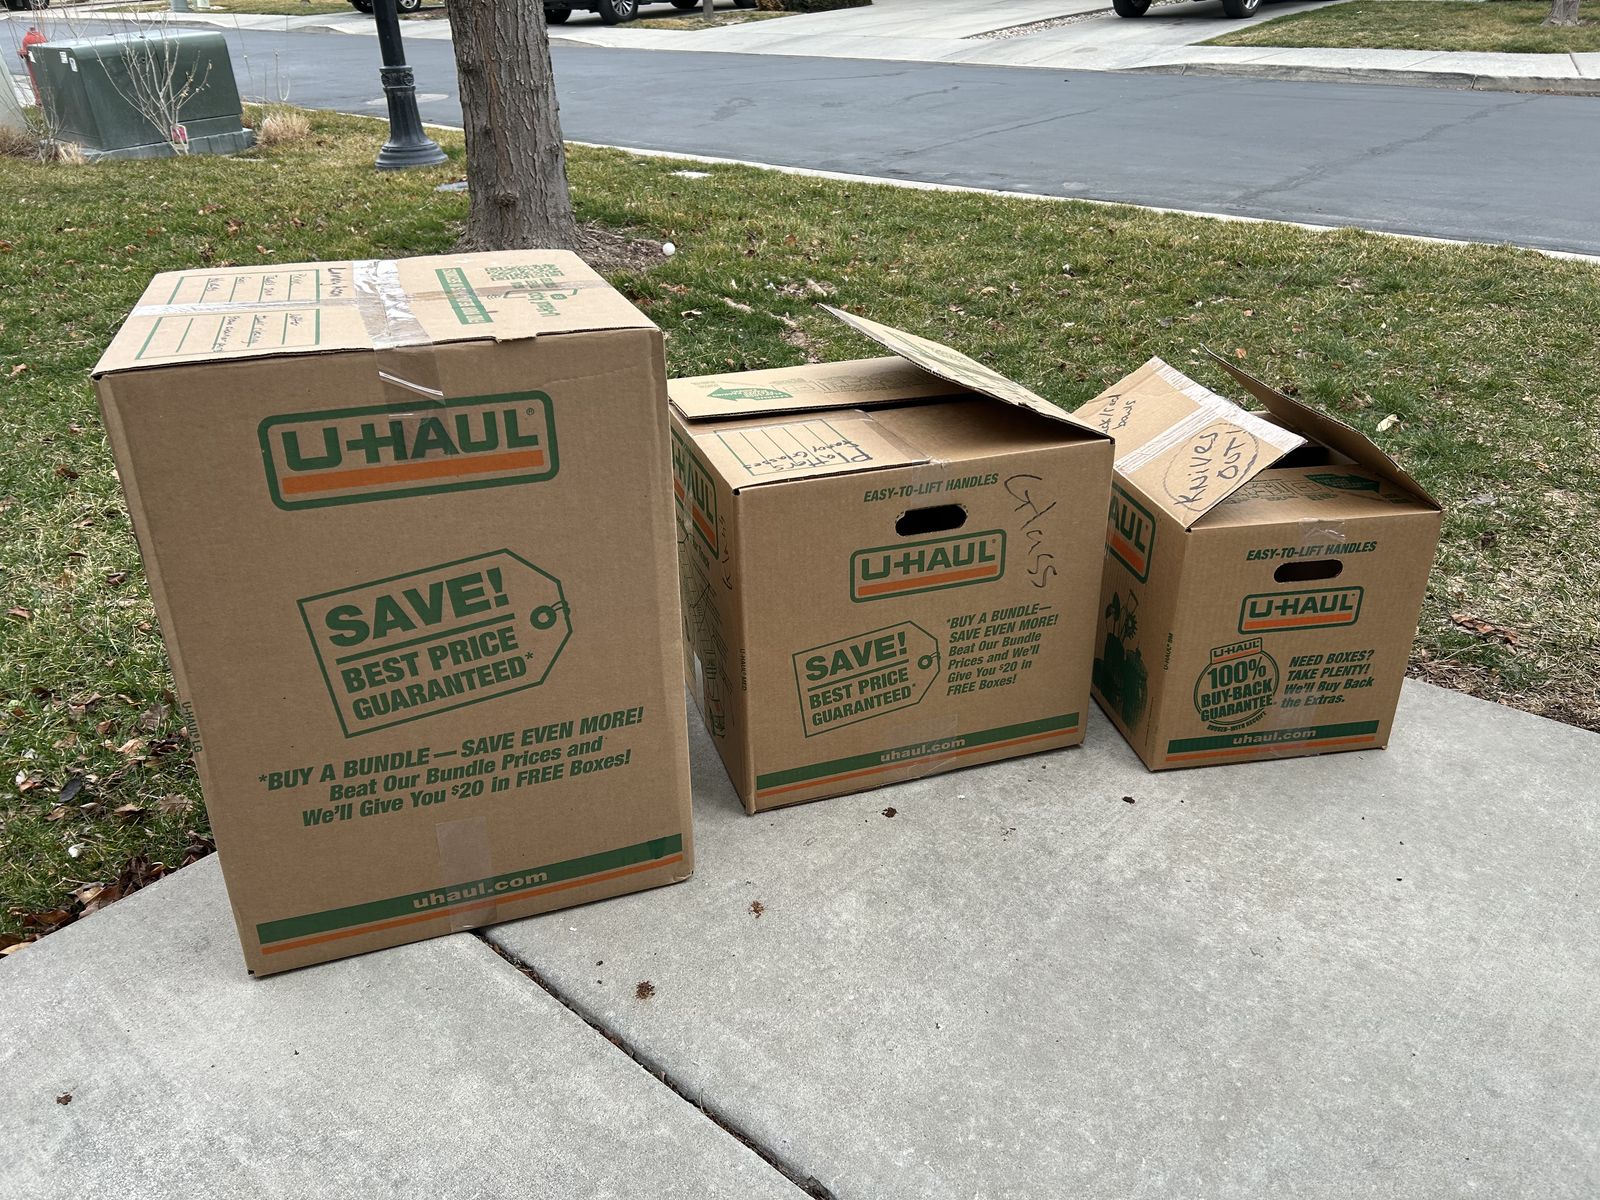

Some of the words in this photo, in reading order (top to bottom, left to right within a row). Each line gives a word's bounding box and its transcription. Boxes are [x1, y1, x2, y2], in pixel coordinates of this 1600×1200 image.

[863, 480, 944, 503] EASY-TO-LIFT
[944, 472, 999, 491] HANDLES
[1003, 474, 1058, 589] Glass
[1246, 545, 1324, 561] EASY-TO-LIFT
[1325, 541, 1377, 555] HANDLES
[325, 566, 510, 647] SAVE!
[977, 612, 987, 624] A
[949, 627, 981, 643] SAVE
[984, 621, 1016, 637] EVEN
[1018, 613, 1059, 631] MORE!
[805, 631, 908, 682] SAVE!
[947, 656, 983, 670] Prices
[987, 650, 1009, 663] and
[1012, 644, 1040, 659] We'll
[949, 643, 976, 657] Beat
[978, 640, 999, 652] Our
[1002, 632, 1041, 648] Bundle
[1213, 640, 1260, 658] U-HAUL
[340, 651, 420, 694] BEST
[427, 625, 519, 671] PRICE
[947, 671, 972, 683] Give
[976, 666, 996, 678] You
[998, 660, 1018, 674] $20
[1021, 660, 1033, 670] in
[1207, 655, 1267, 689] 100%
[1287, 668, 1319, 681] TAKE
[1320, 663, 1371, 678] PLENTY!
[1289, 654, 1323, 668] NEED
[1325, 649, 1375, 664] BOXES?
[809, 683, 853, 710] BEST
[857, 667, 909, 695] PRICE
[946, 681, 976, 696] FREE
[978, 674, 1017, 690] Boxes!
[1201, 678, 1273, 708] BUY-BACK
[1283, 682, 1316, 695] We'll
[1317, 681, 1342, 693] Buy
[1343, 676, 1375, 690] Back
[1201, 694, 1273, 721] GUARANTEE
[1280, 697, 1302, 708] the
[1304, 694, 1345, 706] Extras.
[319, 763, 336, 782] A
[521, 720, 574, 747] EVEN
[579, 706, 645, 735] MORE!
[880, 739, 966, 762] uhaul.com
[1232, 730, 1317, 745] uhaul.com
[329, 778, 378, 801] Beat
[383, 773, 421, 793] Our
[426, 759, 496, 785] Bundle
[501, 748, 562, 771] Prices
[567, 736, 604, 758] and
[302, 803, 353, 827] We'll
[359, 797, 404, 818] Give
[410, 789, 447, 808] You
[451, 779, 485, 799] $20
[491, 776, 510, 793] in
[516, 763, 565, 788] FREE
[569, 748, 632, 777] Boxes!
[413, 872, 549, 909] uhaul.com
